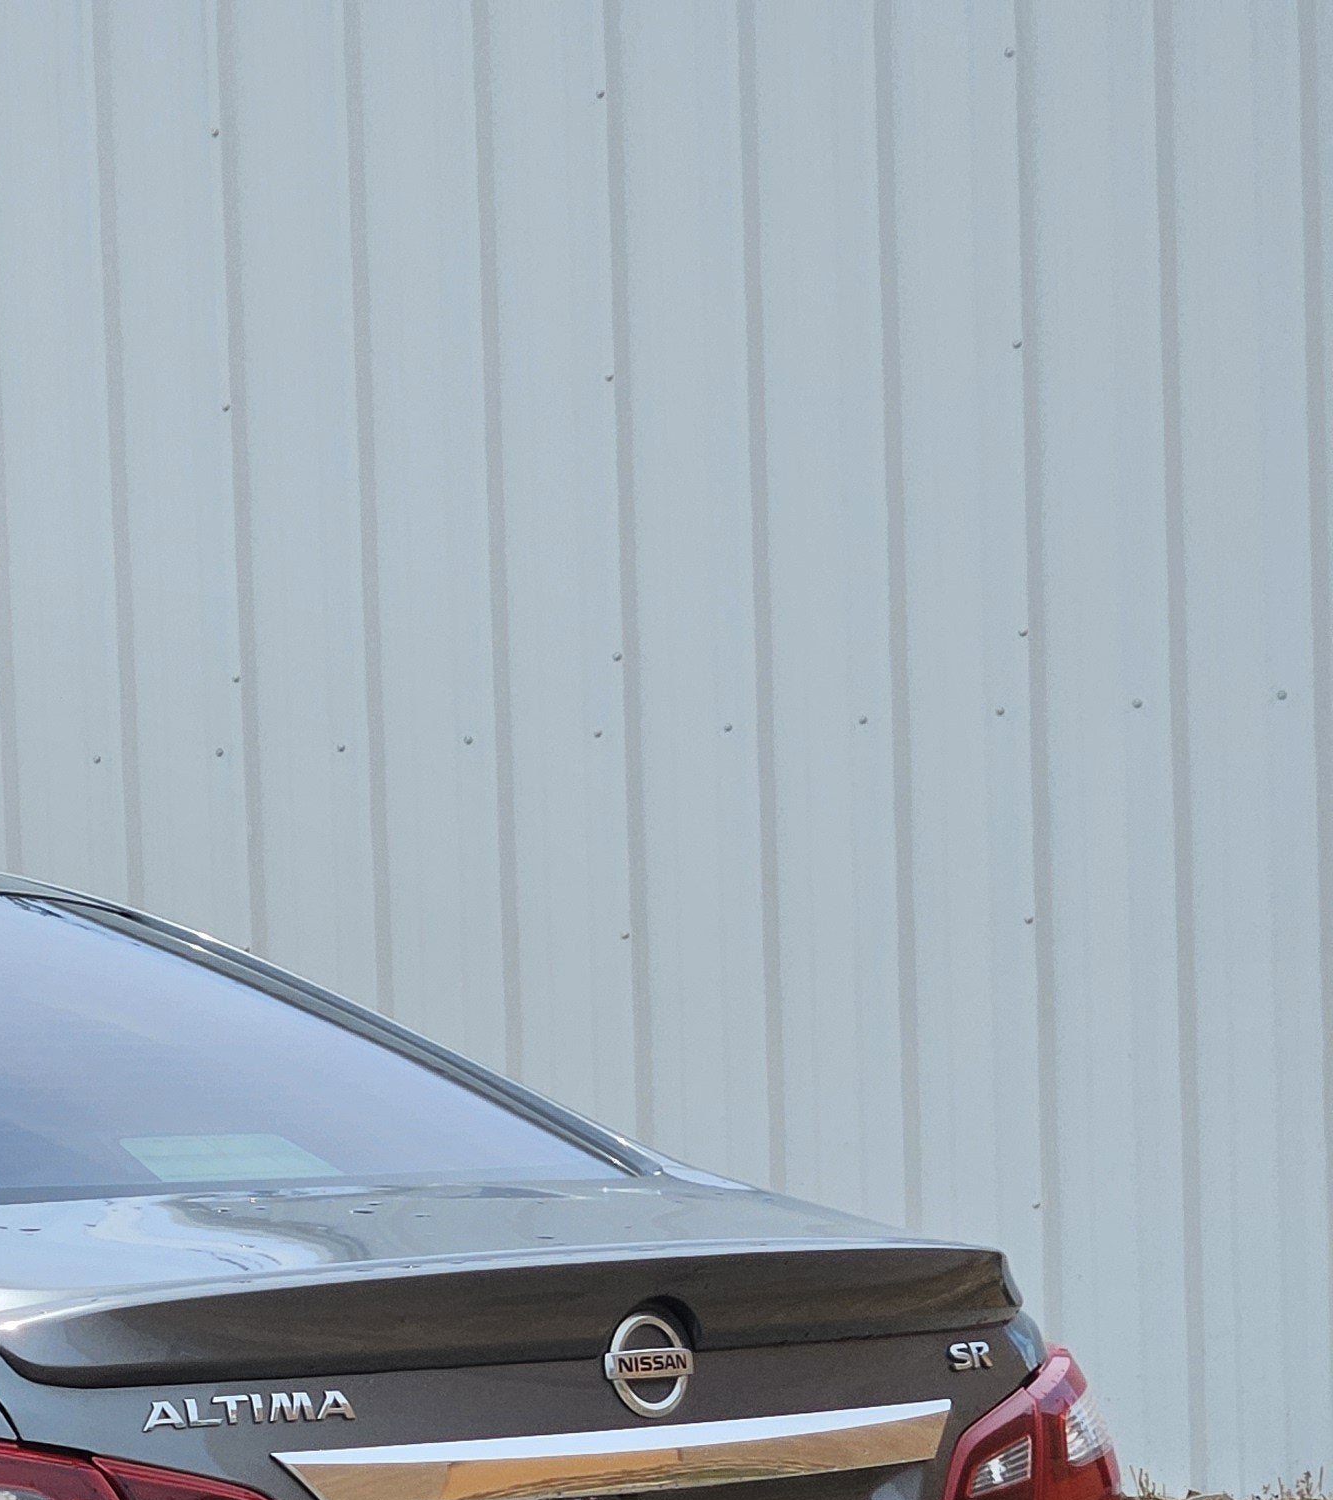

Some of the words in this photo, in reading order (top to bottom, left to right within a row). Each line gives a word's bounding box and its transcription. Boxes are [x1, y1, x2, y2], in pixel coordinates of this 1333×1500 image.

[618, 1353, 687, 1373] NISSAN
[950, 1341, 993, 1370] SR
[143, 1390, 356, 1432] ALTIMA
